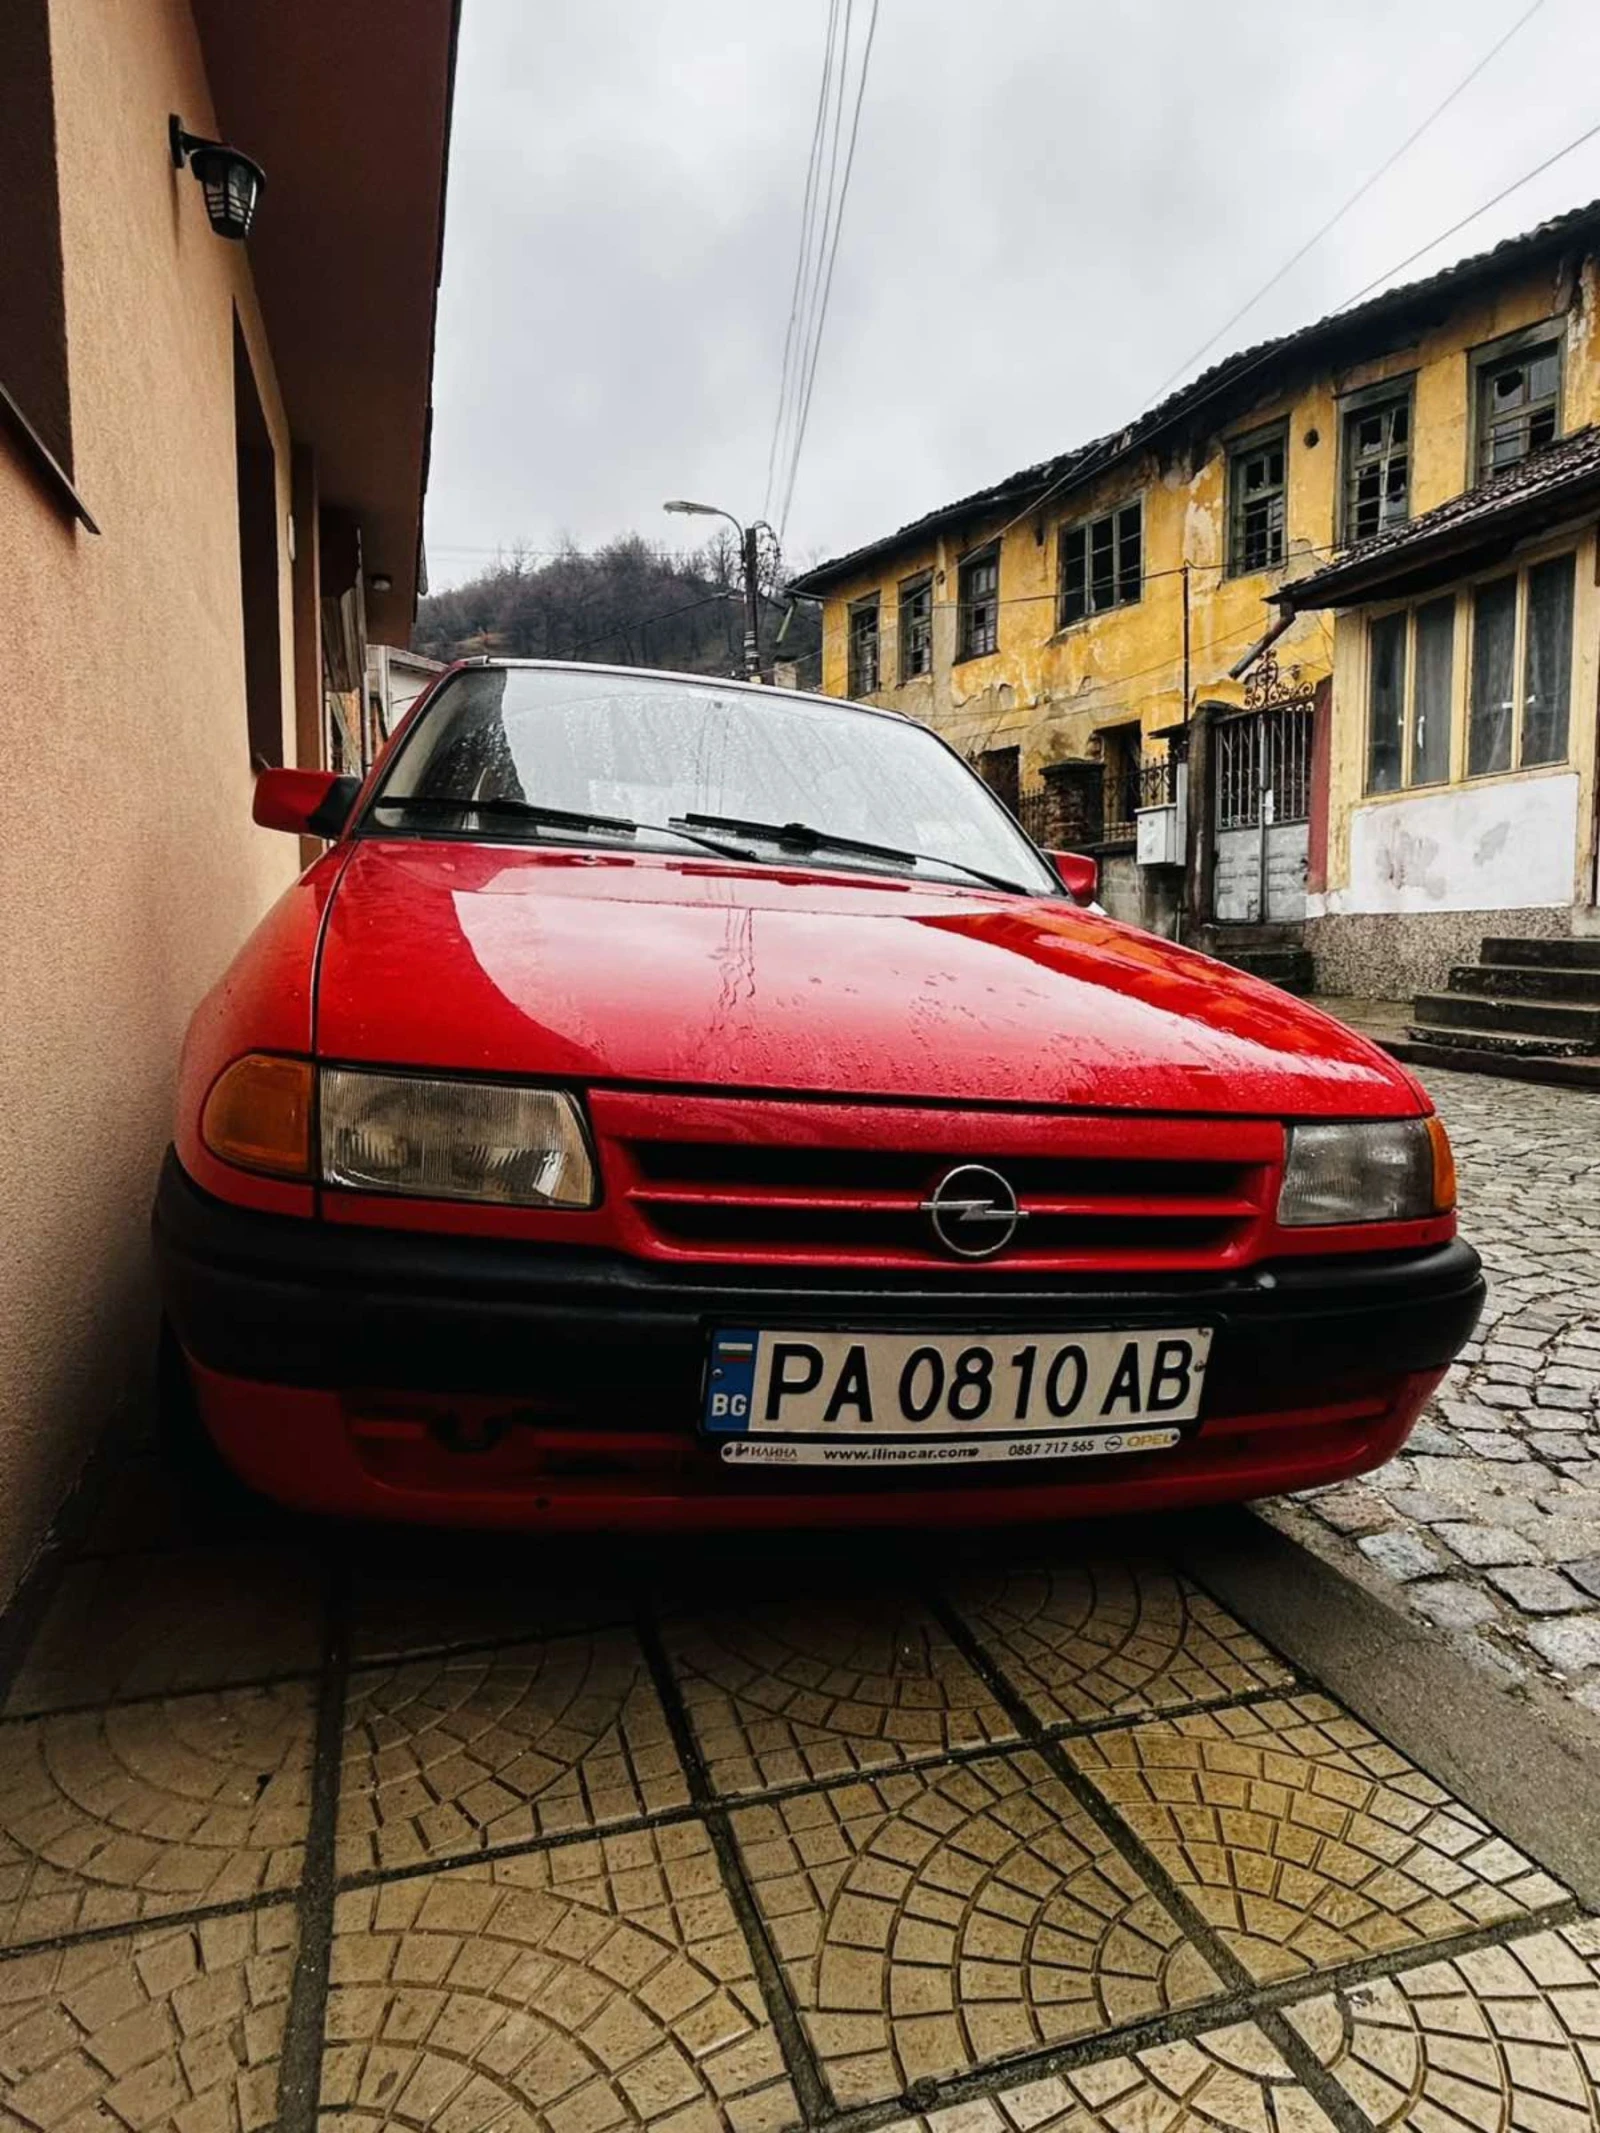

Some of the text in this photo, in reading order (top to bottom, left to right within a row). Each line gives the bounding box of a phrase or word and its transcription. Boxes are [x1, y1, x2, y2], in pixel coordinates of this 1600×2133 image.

[765, 1339, 1193, 1422] PA 0810 AB
[711, 1394, 747, 1416] BG
[1008, 1440, 1094, 1457] 0887 717 565
[1126, 1433, 1172, 1447] OPEL
